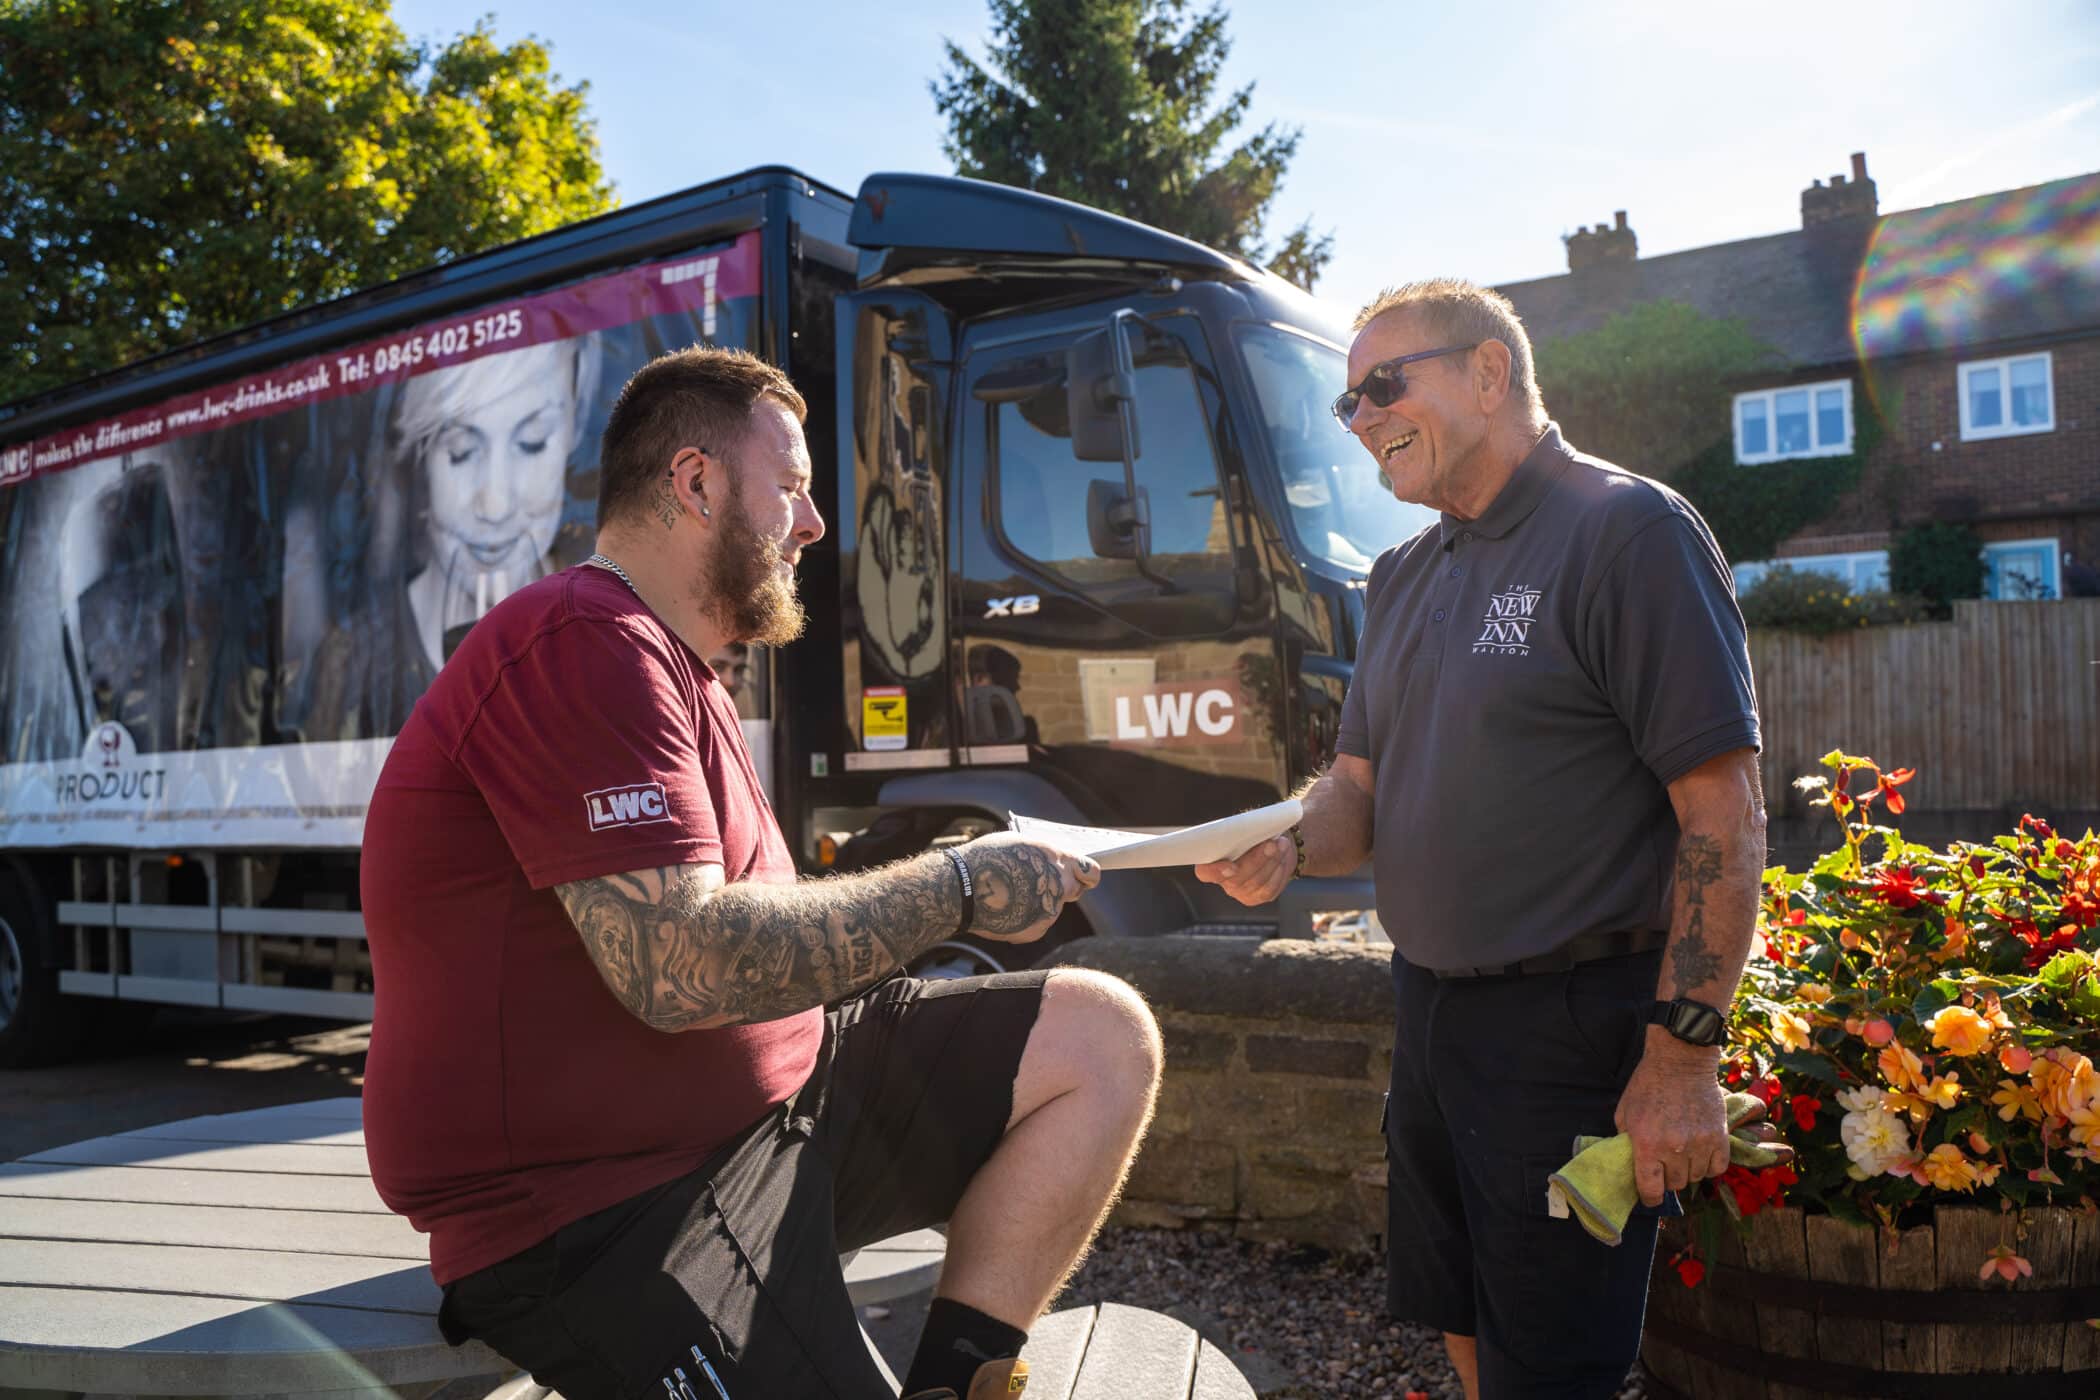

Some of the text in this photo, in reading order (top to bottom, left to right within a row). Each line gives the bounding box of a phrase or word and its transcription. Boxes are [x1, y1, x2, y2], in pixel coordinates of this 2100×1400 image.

[35, 442, 73, 468] makes
[73, 433, 94, 457] the
[95, 421, 163, 450] difference
[167, 364, 331, 428] www.lwc-drinks.co.uk
[337, 353, 370, 384] Tel:
[374, 337, 424, 375] 0845
[427, 325, 469, 357] 402
[473, 310, 522, 348] 5125
[1508, 584, 1529, 592] THE
[983, 595, 1040, 619] XB
[1485, 594, 1541, 617] NEW
[1478, 622, 1531, 643] INN
[1115, 690, 1235, 740] LWC
[56, 769, 166, 803] PRODUCT
[591, 790, 663, 824] LWC
